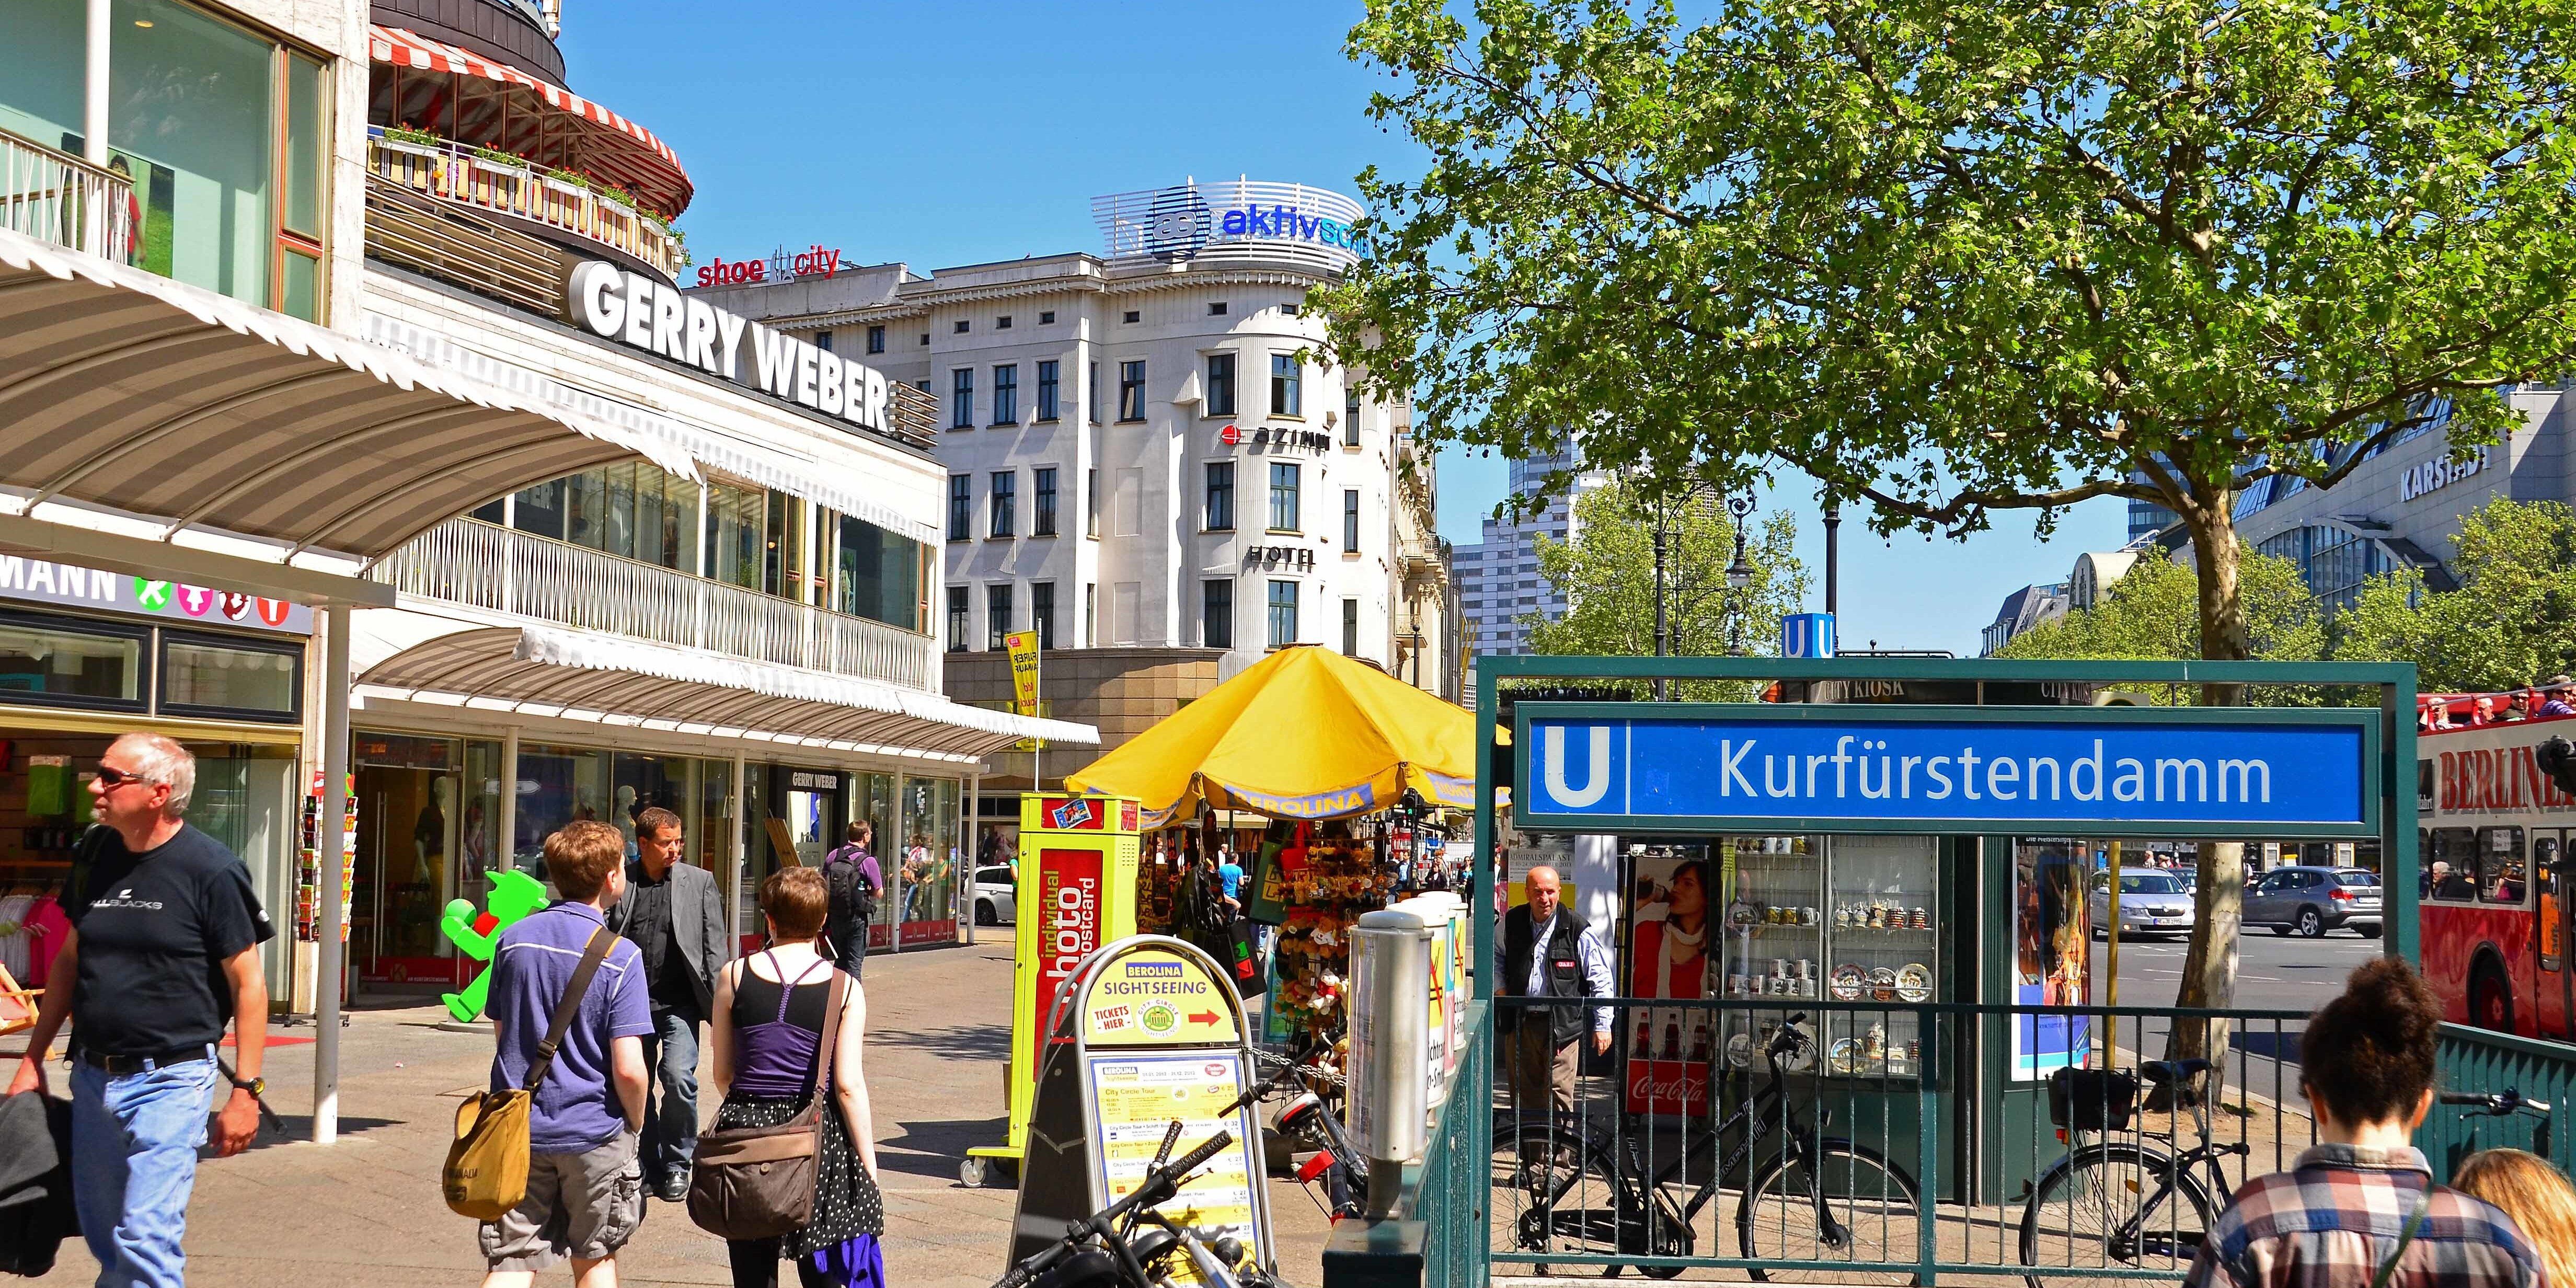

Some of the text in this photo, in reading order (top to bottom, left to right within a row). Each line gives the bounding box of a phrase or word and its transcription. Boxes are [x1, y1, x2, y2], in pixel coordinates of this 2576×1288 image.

[697, 245, 840, 288] shoe city
[569, 261, 889, 433] GERRY WEBER
[1250, 545, 1316, 566] HOTEL
[1823, 679, 1905, 702] CITY KIOSK
[2041, 681, 2070, 699] CITY
[1544, 726, 2270, 808] U Kurfürstendamm
[792, 772, 837, 789] GERRY WEBER
[2439, 745, 2576, 810] BERLINE
[1509, 853, 1571, 862] ADMIRALSPALAST
[1041, 870, 1060, 958] individual
[1128, 965, 1182, 978] BEROLINA
[1104, 981, 1207, 995] SIGHTSEEING
[1094, 1005, 1130, 1021] TICKETS
[1138, 999, 1179, 1016] CITY CIRCLE
[1104, 1018, 1124, 1030] HIER
[1611, 1217, 1642, 1226] TIUMPH
